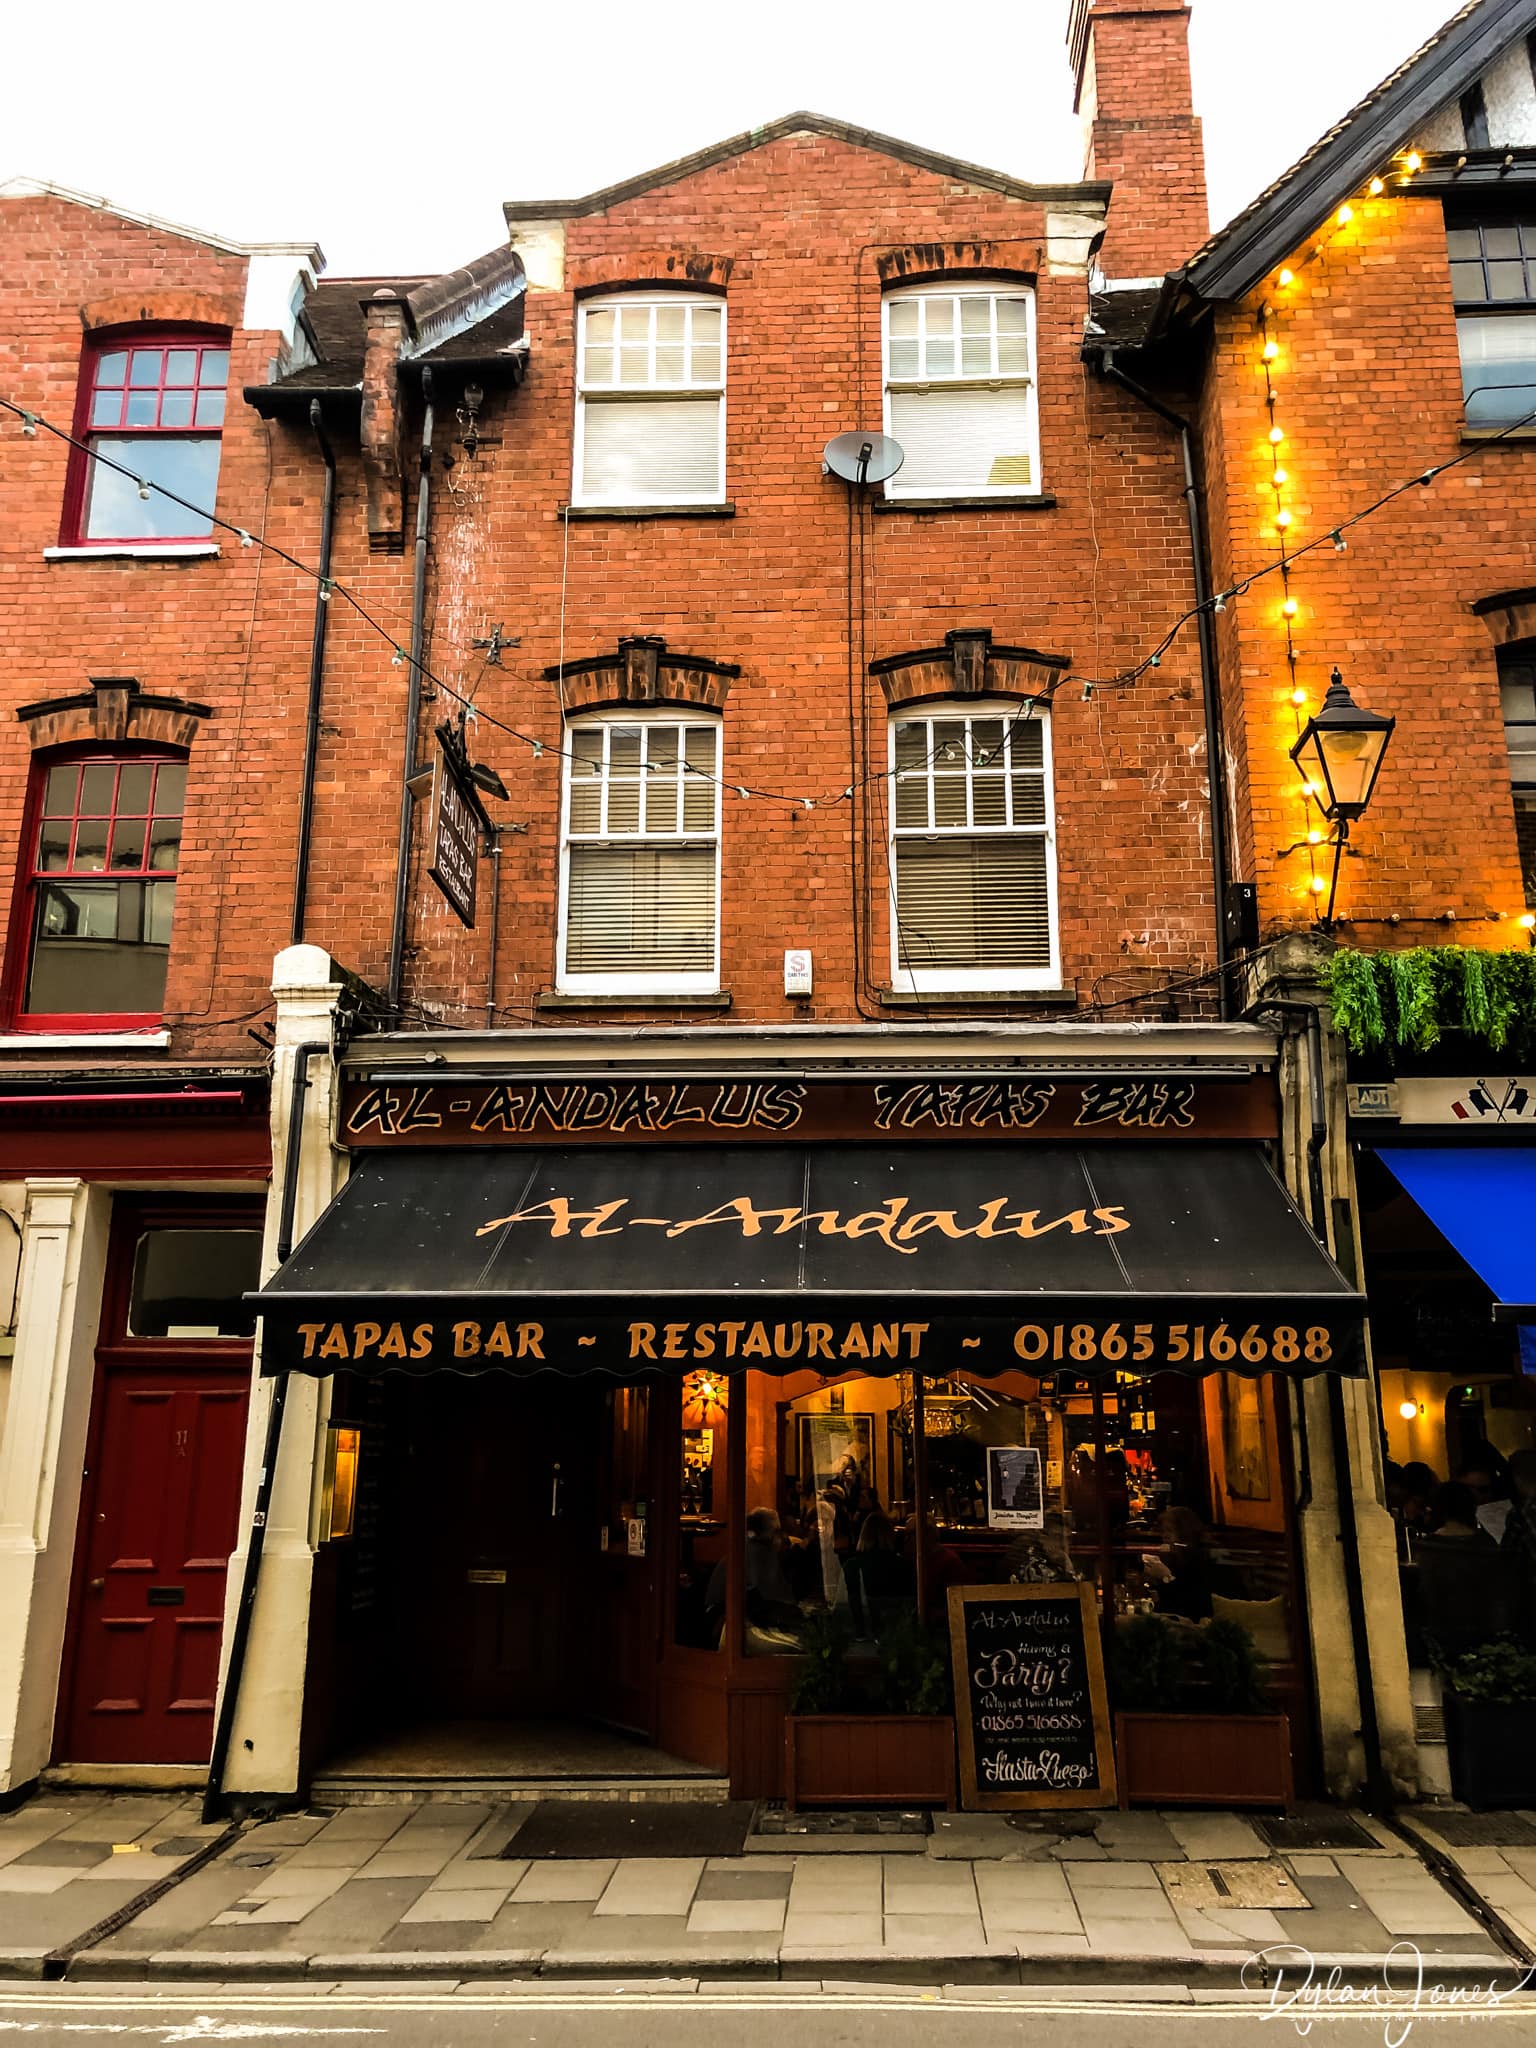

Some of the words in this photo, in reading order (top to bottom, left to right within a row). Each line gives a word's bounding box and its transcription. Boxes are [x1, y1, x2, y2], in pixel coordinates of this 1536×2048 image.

[1243, 888, 1251, 898] 3
[347, 1084, 807, 1135] AL-ANDALUS
[873, 1083, 1057, 1129] TAPAS
[1073, 1082, 1196, 1128] BAR
[1360, 1090, 1388, 1105] ADT
[298, 1322, 433, 1359] TAPAS
[451, 1322, 546, 1360] BAR
[627, 1321, 930, 1361] RESTAURANT
[1017, 1642, 1057, 1658] Having
[974, 1648, 1071, 1696] Party?
[980, 1690, 1006, 1714] Why
[981, 1714, 1024, 1732] 01865
[1026, 1712, 1082, 1731] 516688
[981, 1750, 1038, 1782] Hasta
